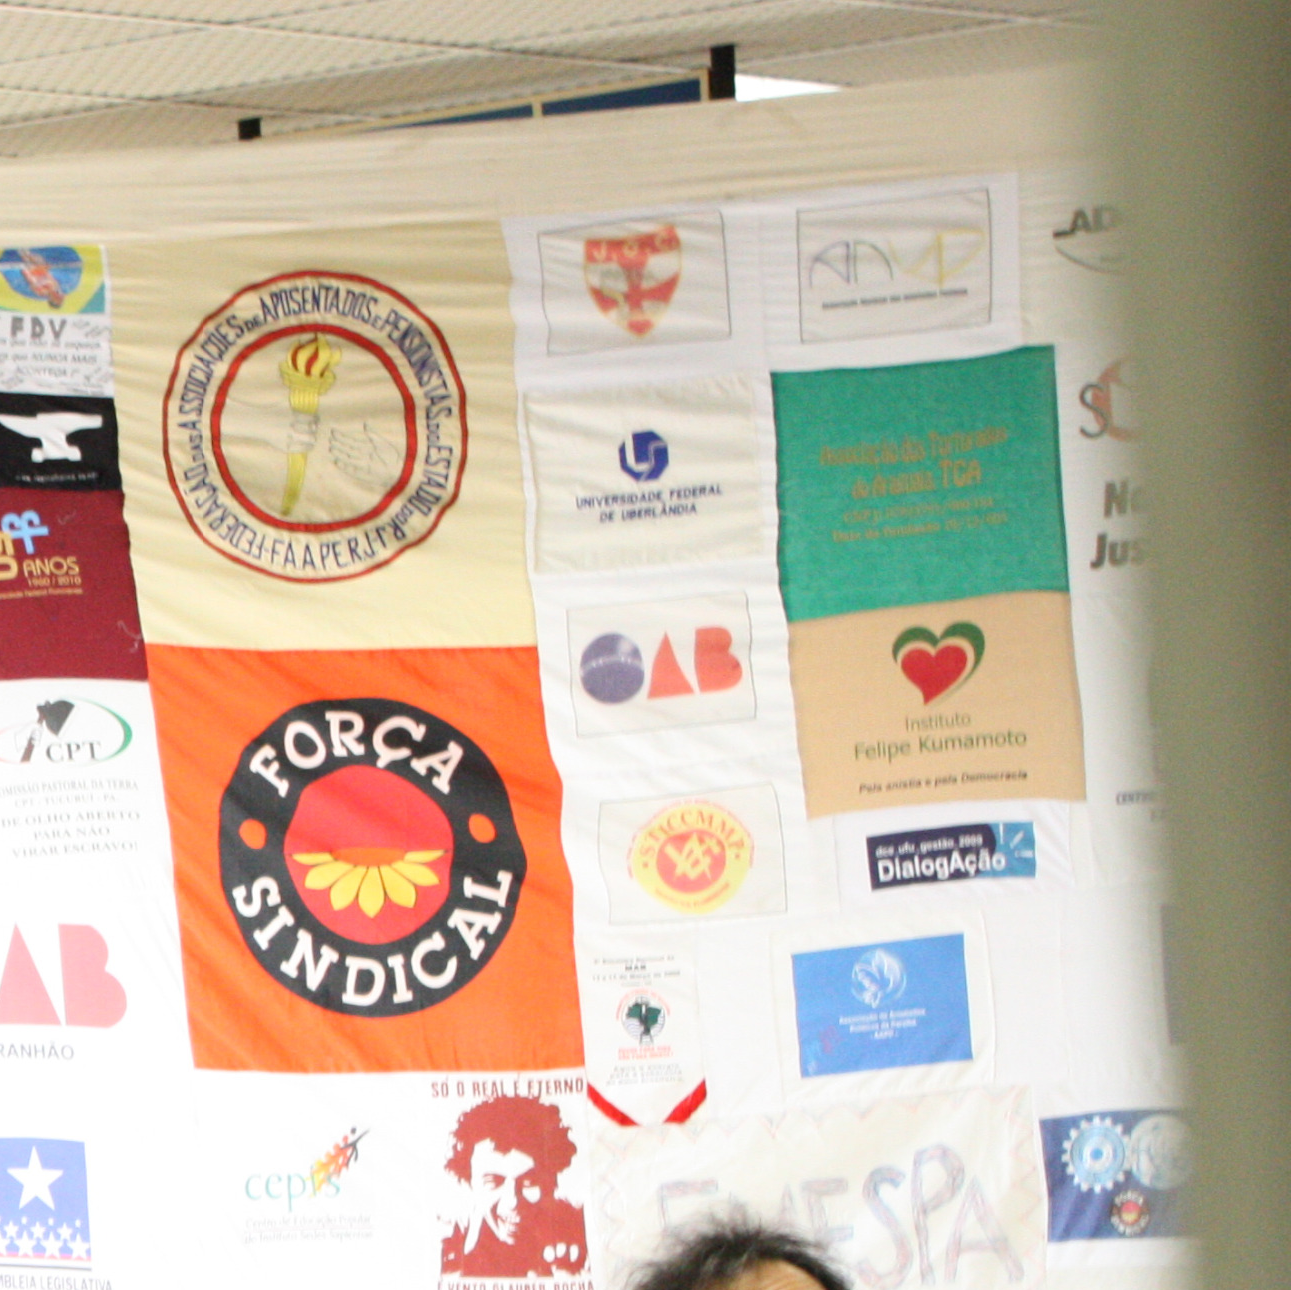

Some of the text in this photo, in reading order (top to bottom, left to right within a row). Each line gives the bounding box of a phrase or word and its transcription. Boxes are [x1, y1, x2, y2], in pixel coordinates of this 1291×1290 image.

[259, 283, 379, 324] APOSENTADOS
[576, 484, 722, 509] UNIVERSIDADE FEDERAL
[600, 503, 697, 522] DE UBERLÂNDIA
[23, 556, 79, 577] ANOS
[905, 712, 971, 731] Instituto
[45, 740, 101, 763] CPT
[250, 711, 464, 797] FORÇA
[854, 730, 1027, 764] Felipe Kumamoto
[42, 779, 88, 793] PASTORAL
[91, 778, 104, 790] DA
[107, 778, 139, 791] TERRA
[25, 812, 70, 827] OLHO
[76, 810, 141, 822] ABERTO
[33, 828, 72, 841] PARA
[878, 850, 1006, 883] DialogAção
[232, 868, 513, 1007] SINDICAL
[456, 1081, 465, 1098] O
[472, 1080, 506, 1098] REAL
[527, 1077, 583, 1098] ETERNO
[244, 1164, 340, 1213] cepis
